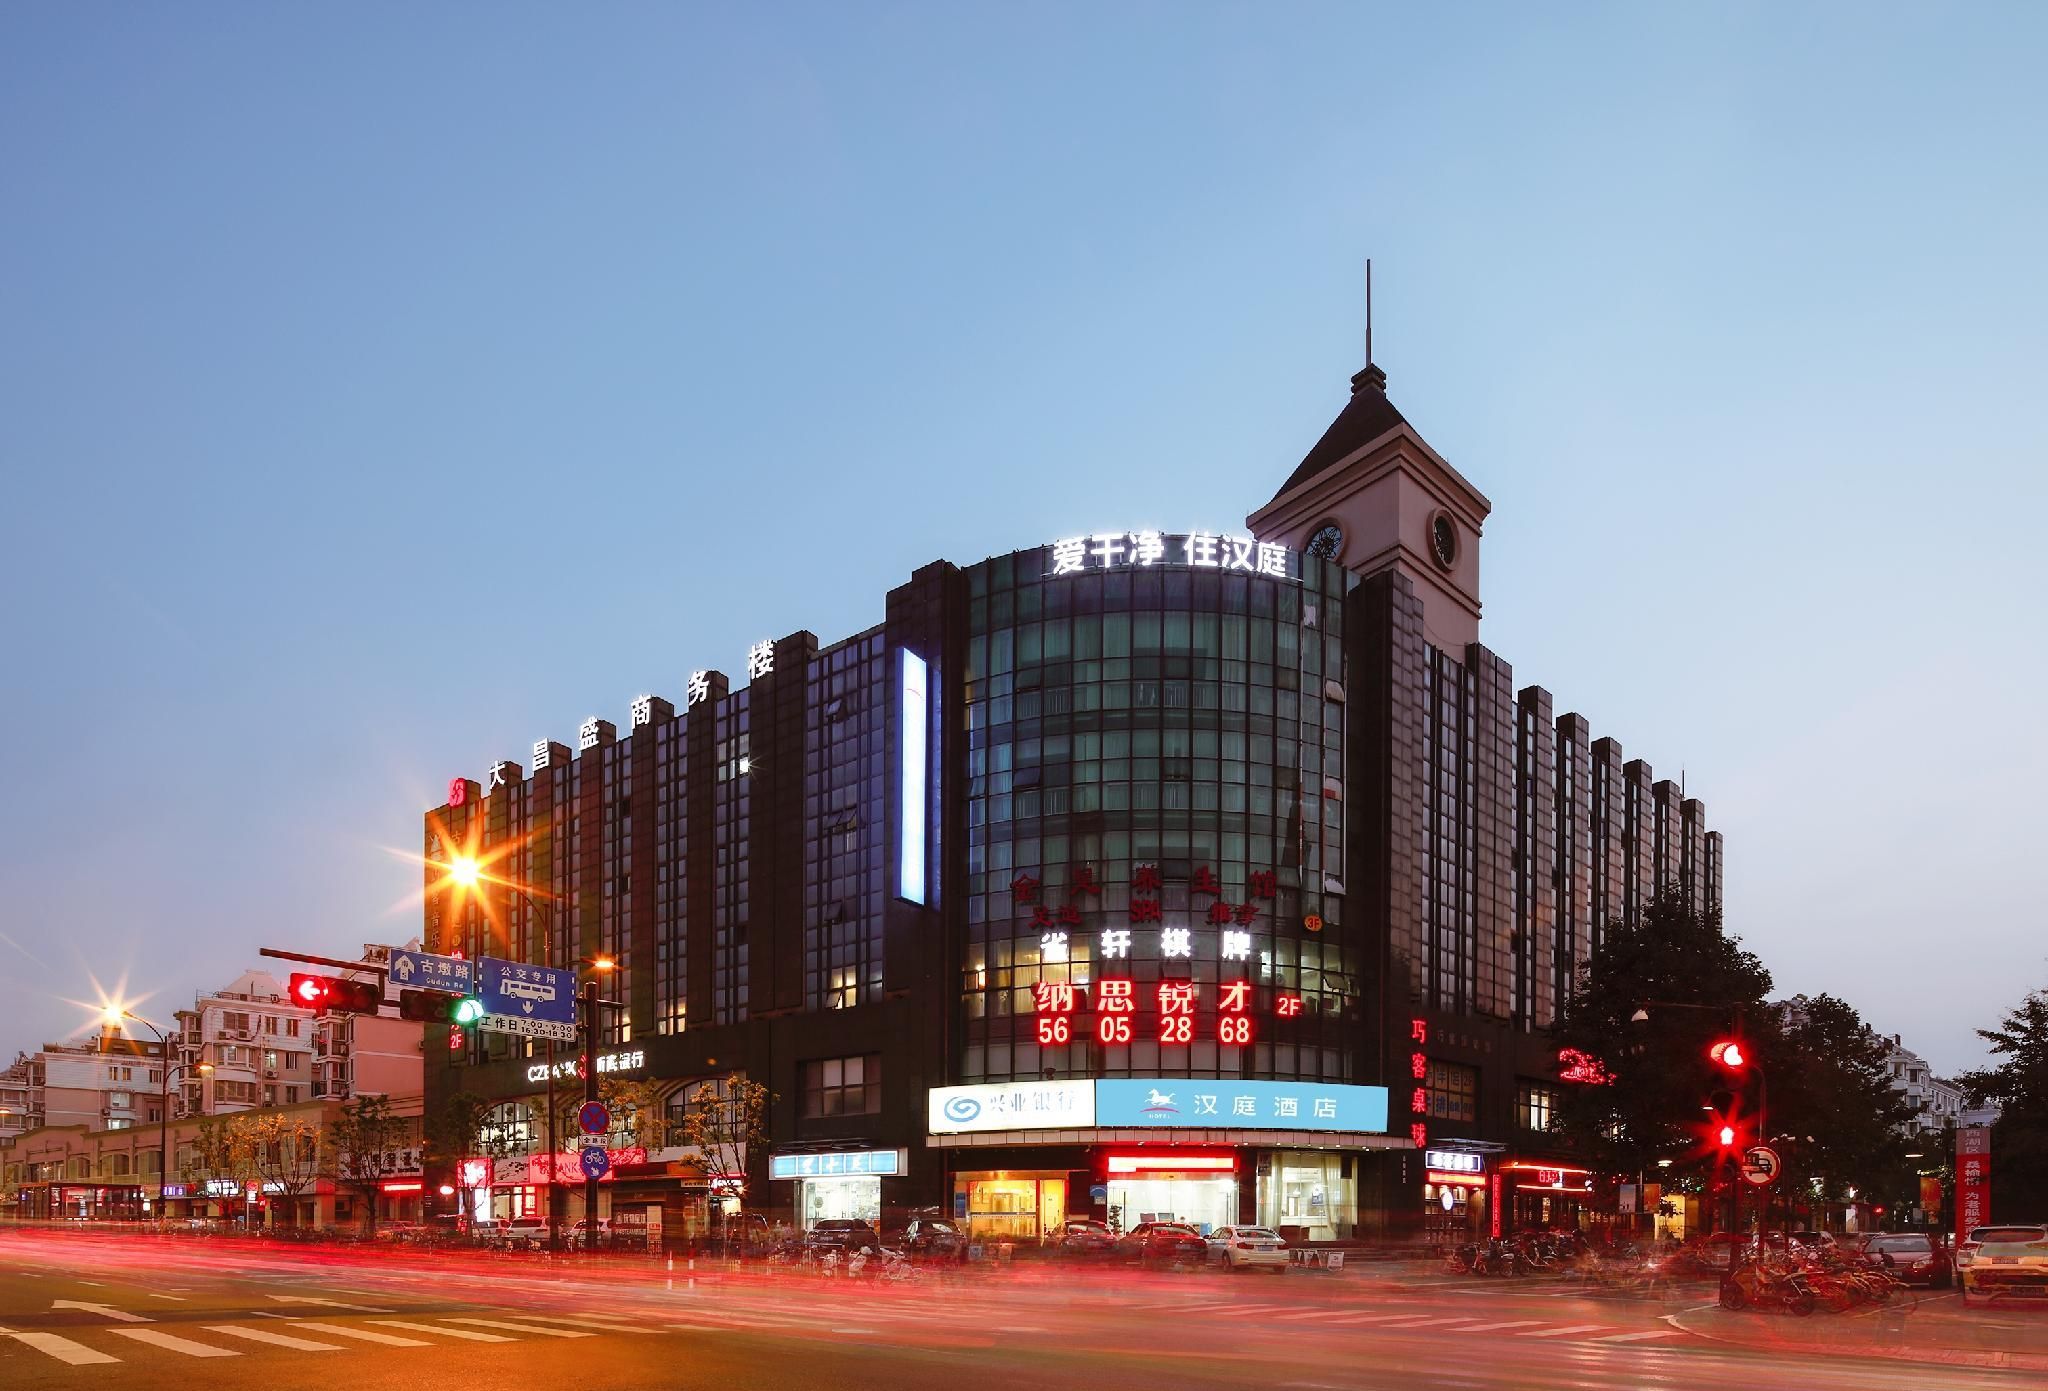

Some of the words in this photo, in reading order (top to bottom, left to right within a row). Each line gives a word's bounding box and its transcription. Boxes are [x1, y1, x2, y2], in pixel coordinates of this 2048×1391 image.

[1052, 531, 1164, 575] 爱干净
[1183, 531, 1287, 577] 住汉庭
[489, 638, 776, 789] 大昌盛商务楼
[1130, 899, 1162, 922] SPA
[420, 959, 470, 980] 古墩路
[500, 966, 556, 985] 公交专用
[1278, 997, 1300, 1016] 2F
[481, 1016, 518, 1031] 工作日
[1039, 1018, 1068, 1043] 56
[1101, 1017, 1130, 1042] 05
[1161, 1017, 1191, 1042] 28
[1220, 1018, 1250, 1043] 68
[1411, 1019, 1427, 1148] 巧客桌球
[989, 1090, 1077, 1113] 兴业银行
[1194, 1093, 1337, 1119] 汉庭酒店
